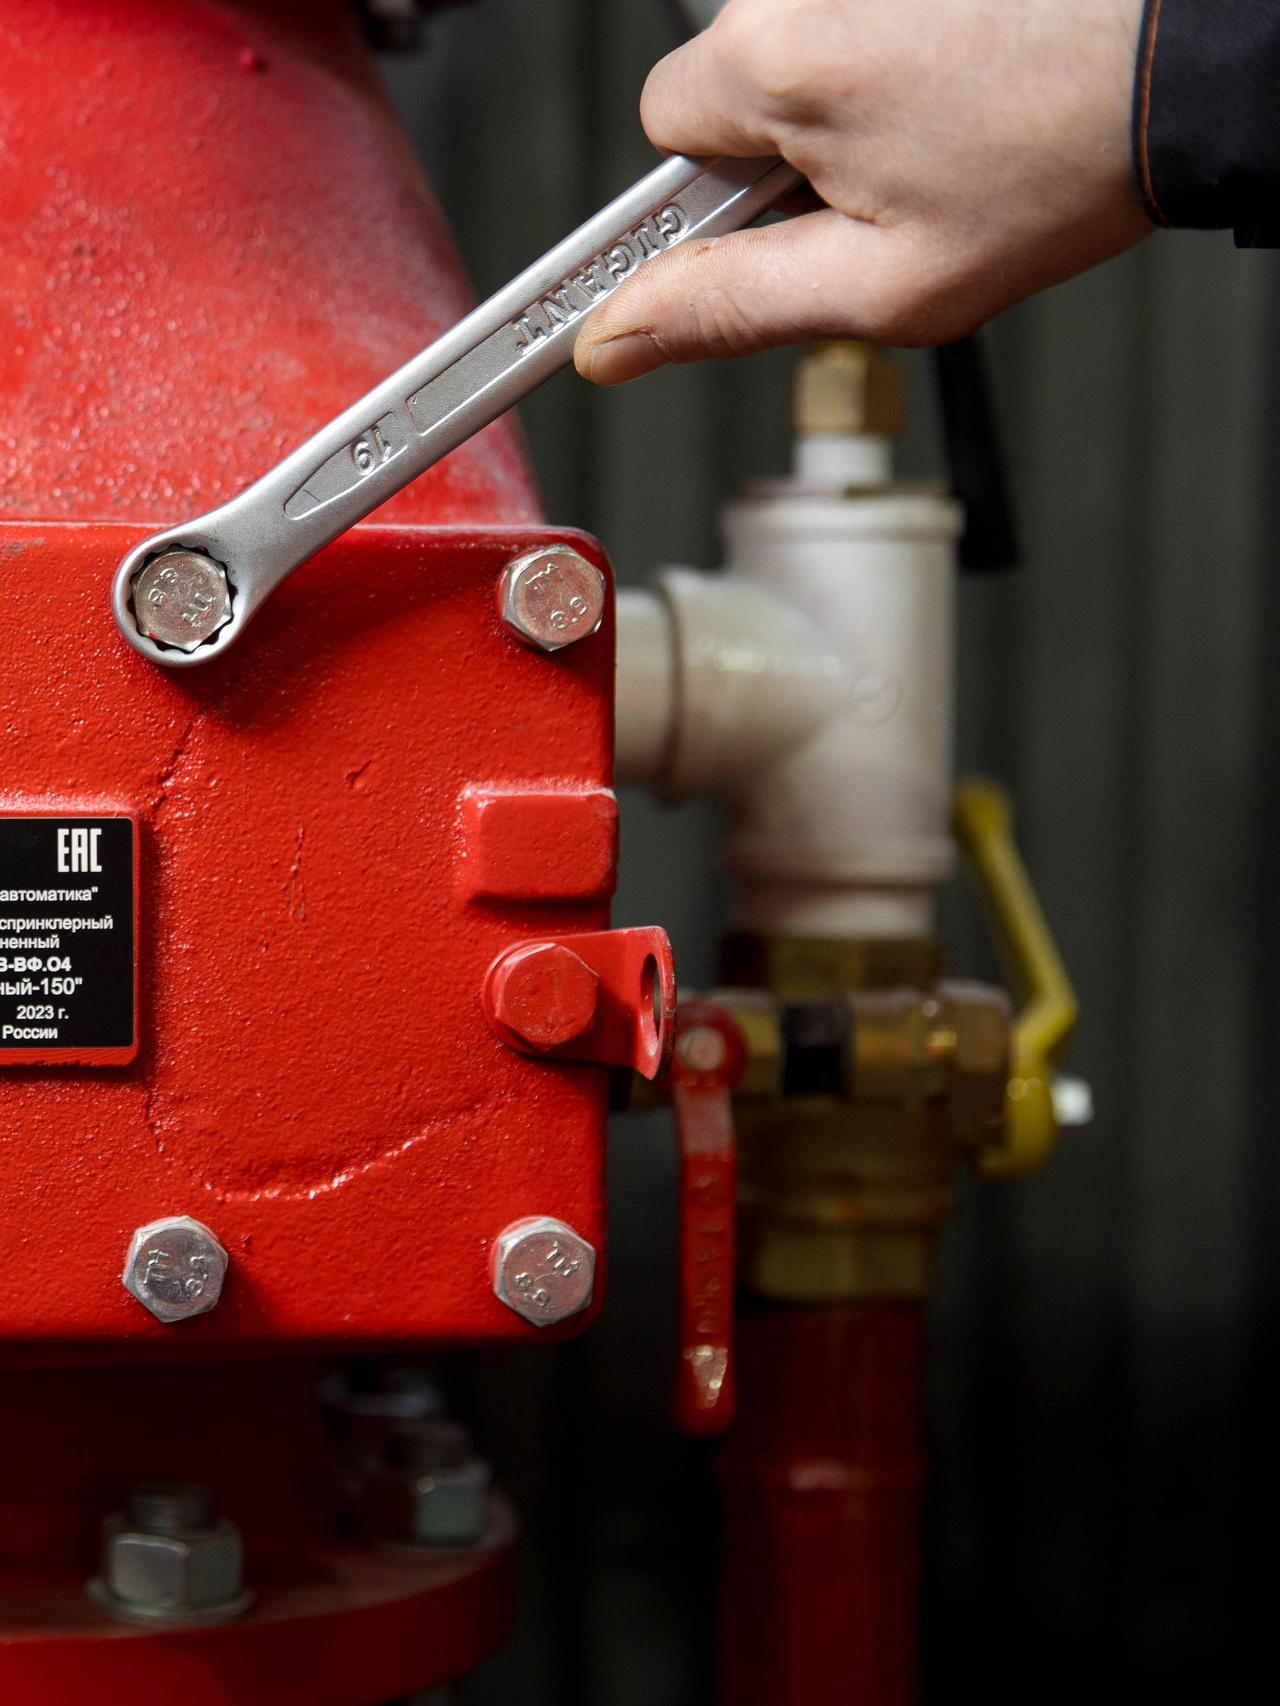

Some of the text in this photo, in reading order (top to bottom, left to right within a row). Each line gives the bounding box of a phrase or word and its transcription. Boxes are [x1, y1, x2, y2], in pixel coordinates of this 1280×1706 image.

[515, 202, 691, 356] GIGANT
[349, 425, 393, 477] 19
[17, 1005, 54, 1019] 2023
[58, 1008, 69, 1019] г.
[3, 1025, 58, 1039] России
